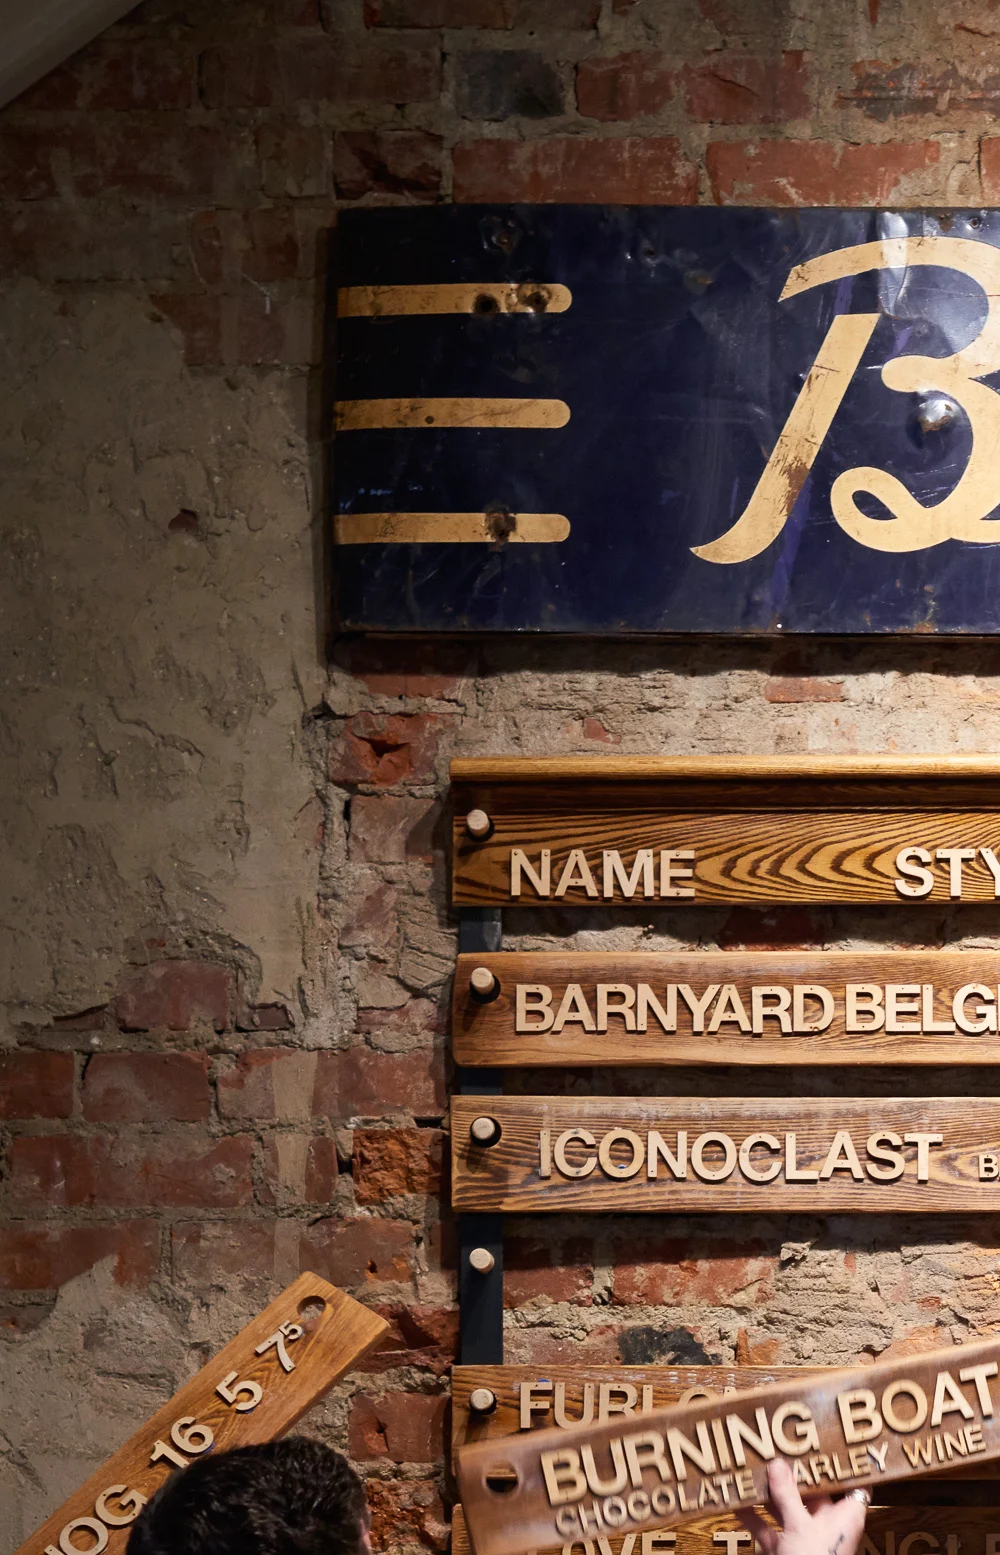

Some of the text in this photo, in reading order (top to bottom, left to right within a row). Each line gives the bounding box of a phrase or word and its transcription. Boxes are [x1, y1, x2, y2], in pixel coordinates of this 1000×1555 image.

[510, 848, 696, 898] NAME
[515, 983, 835, 1036] BARNYARD
[538, 1128, 944, 1182] ICONOCLAST
[150, 1416, 215, 1468] 16
[216, 1370, 263, 1413] 5
[541, 1361, 999, 1506] BURNING BOAT
[555, 1423, 988, 1538] CHOCOLATE ARLEY WINE
